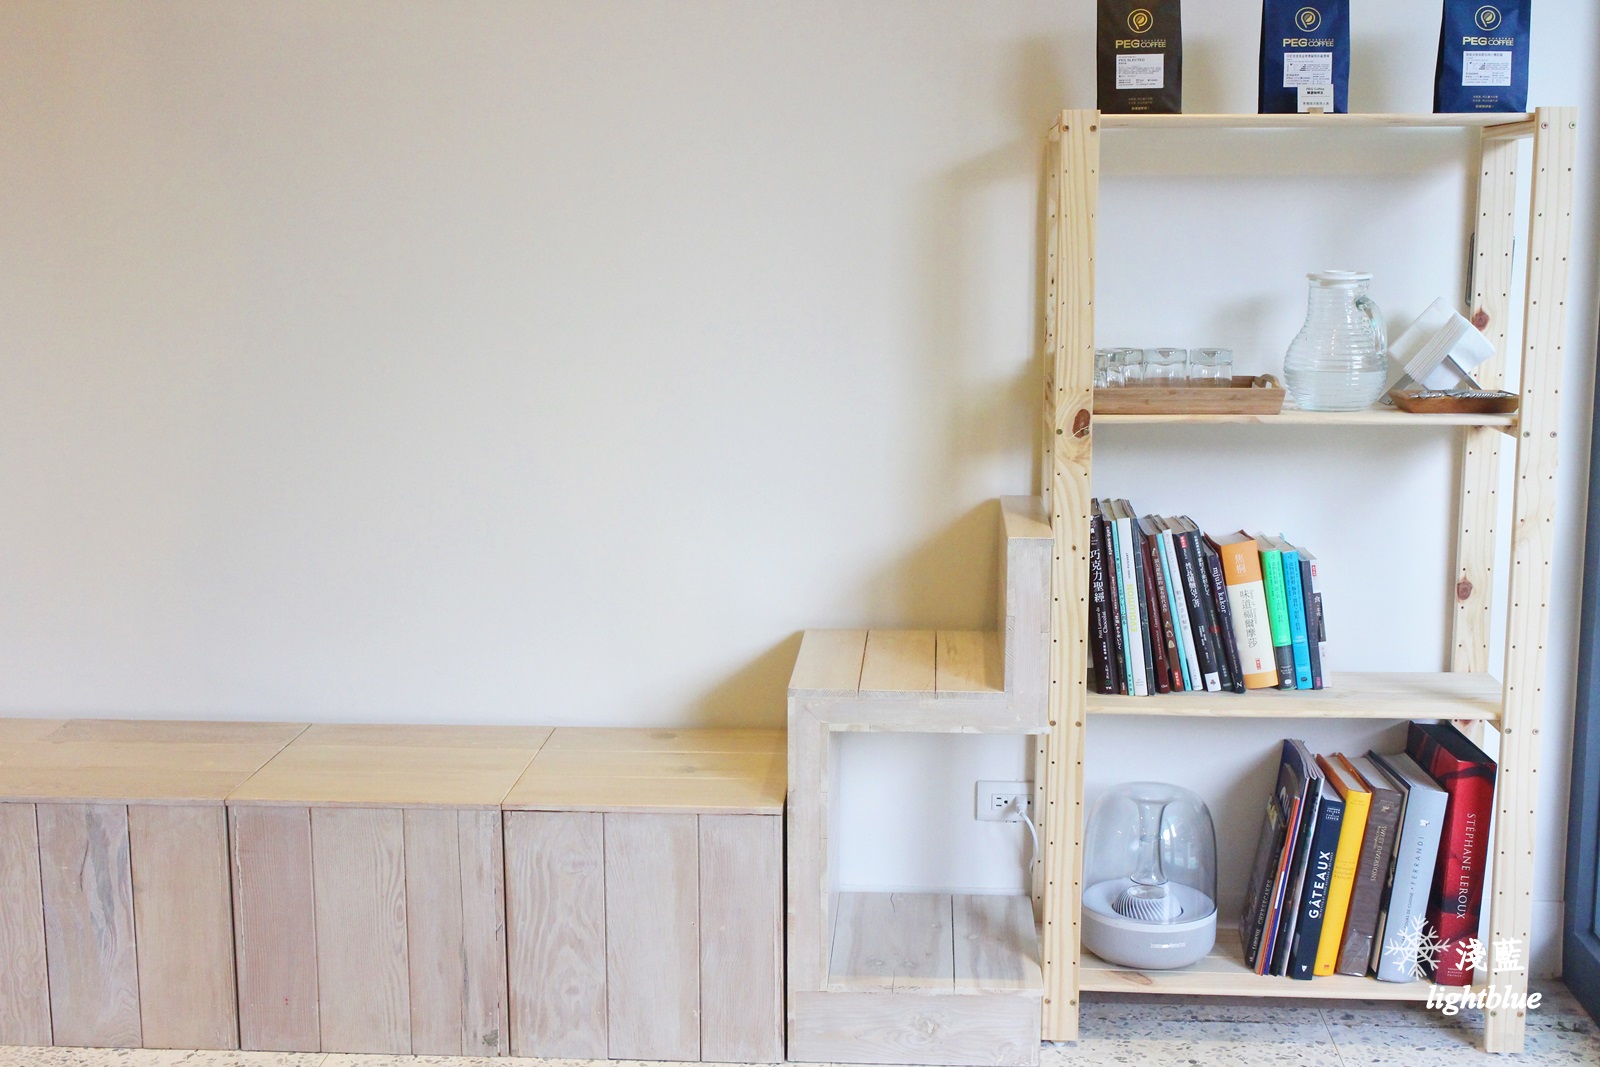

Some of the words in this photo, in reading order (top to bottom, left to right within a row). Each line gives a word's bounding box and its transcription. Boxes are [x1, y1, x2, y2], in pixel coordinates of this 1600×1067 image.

[1116, 39, 1140, 49] PEG
[1283, 38, 1307, 47] PEG
[1463, 37, 1487, 46] PEG
[1127, 583, 1138, 633] EVOLUTION
[1212, 566, 1222, 591] mjuka
[1217, 591, 1226, 613] kakor
[1410, 836, 1425, 885] FERRANDI
[1461, 813, 1476, 871] STÉPHANE
[1258, 879, 1272, 925] CHEESECAKES
[1308, 850, 1330, 919] GÂTEAUX
[1457, 872, 1469, 919] LEROUX
